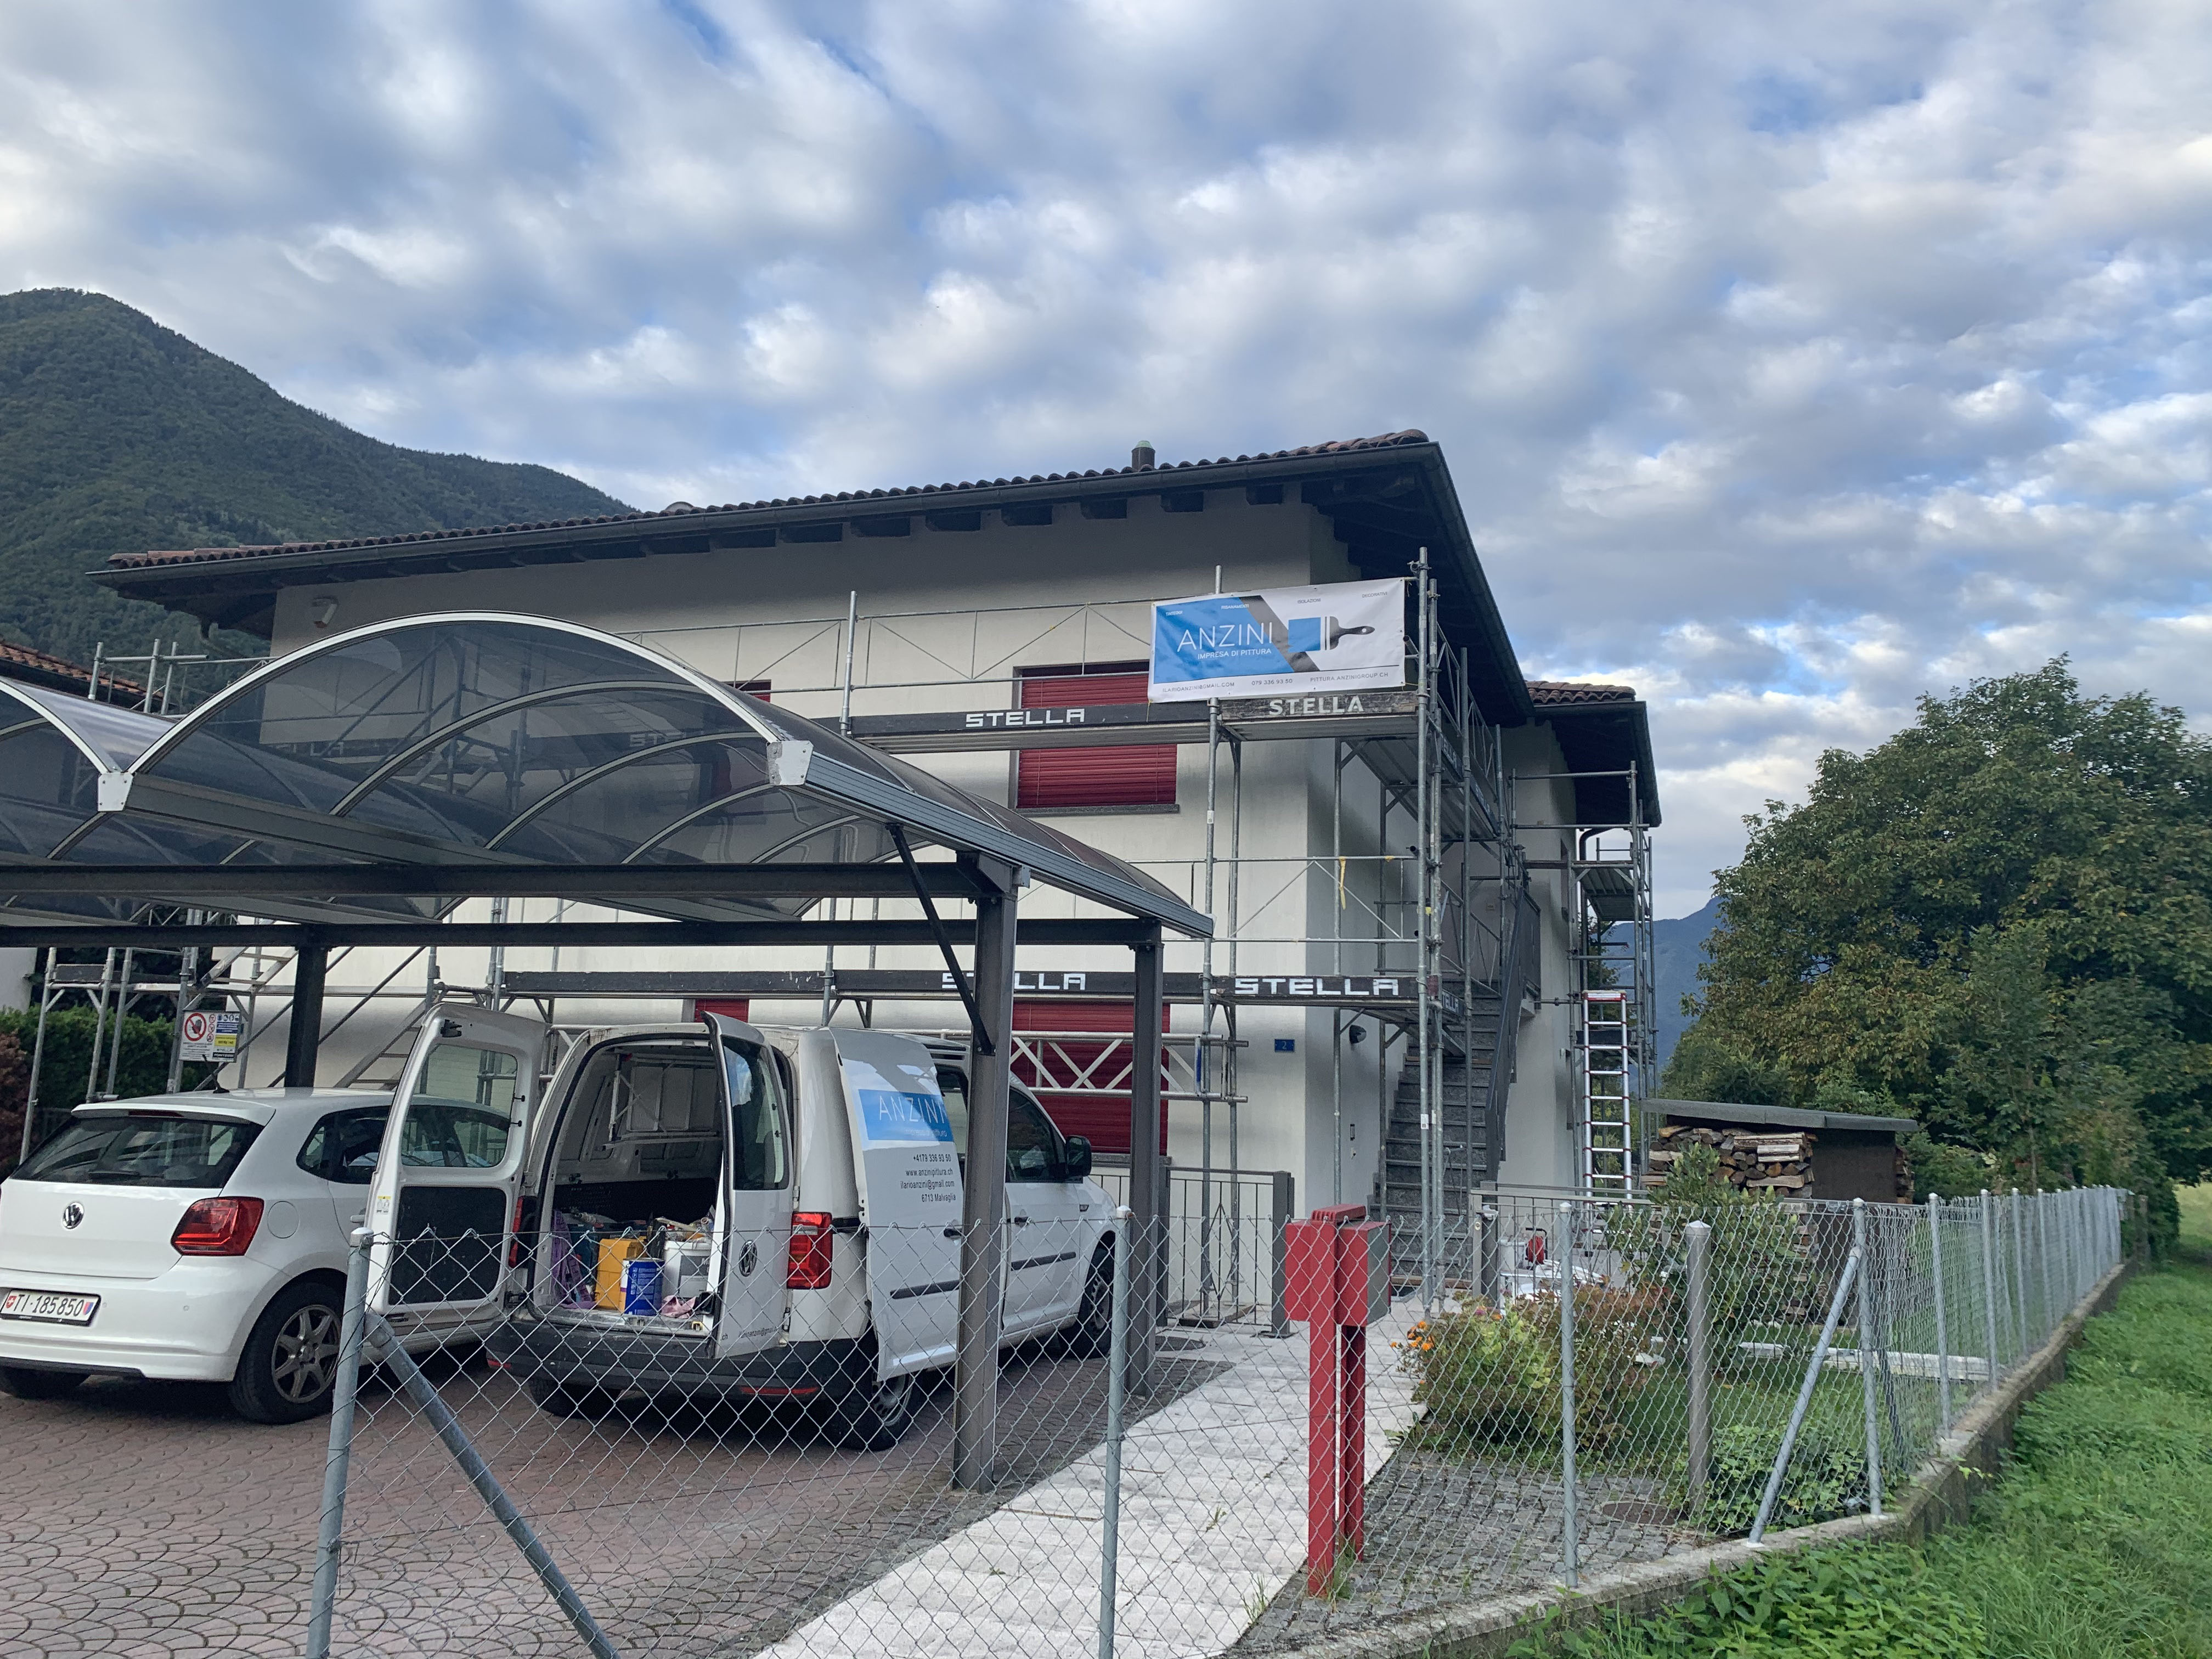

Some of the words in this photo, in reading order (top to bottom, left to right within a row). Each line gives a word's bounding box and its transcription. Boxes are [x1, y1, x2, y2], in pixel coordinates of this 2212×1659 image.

[1177, 622, 1272, 652] ANZINI
[1198, 651, 1228, 659] IMPRESA
[1269, 695, 1364, 715] STELLA
[966, 708, 1085, 727] STELLA
[941, 972, 1086, 990] SLLA
[1234, 978, 1399, 996] STELLA
[1282, 1041, 1287, 1049] 2
[879, 1096, 945, 1124] ANZINI
[913, 1154, 928, 1162] +4179
[928, 1154, 938, 1162] 336
[938, 1154, 944, 1162] 93
[945, 1154, 951, 1162] 50
[905, 1168, 953, 1178] www.anzinipittura.ch
[900, 1180, 955, 1190] ilarioanzini@gmail.com
[922, 1194, 934, 1202] 6713
[934, 1193, 956, 1203] Malvaglia
